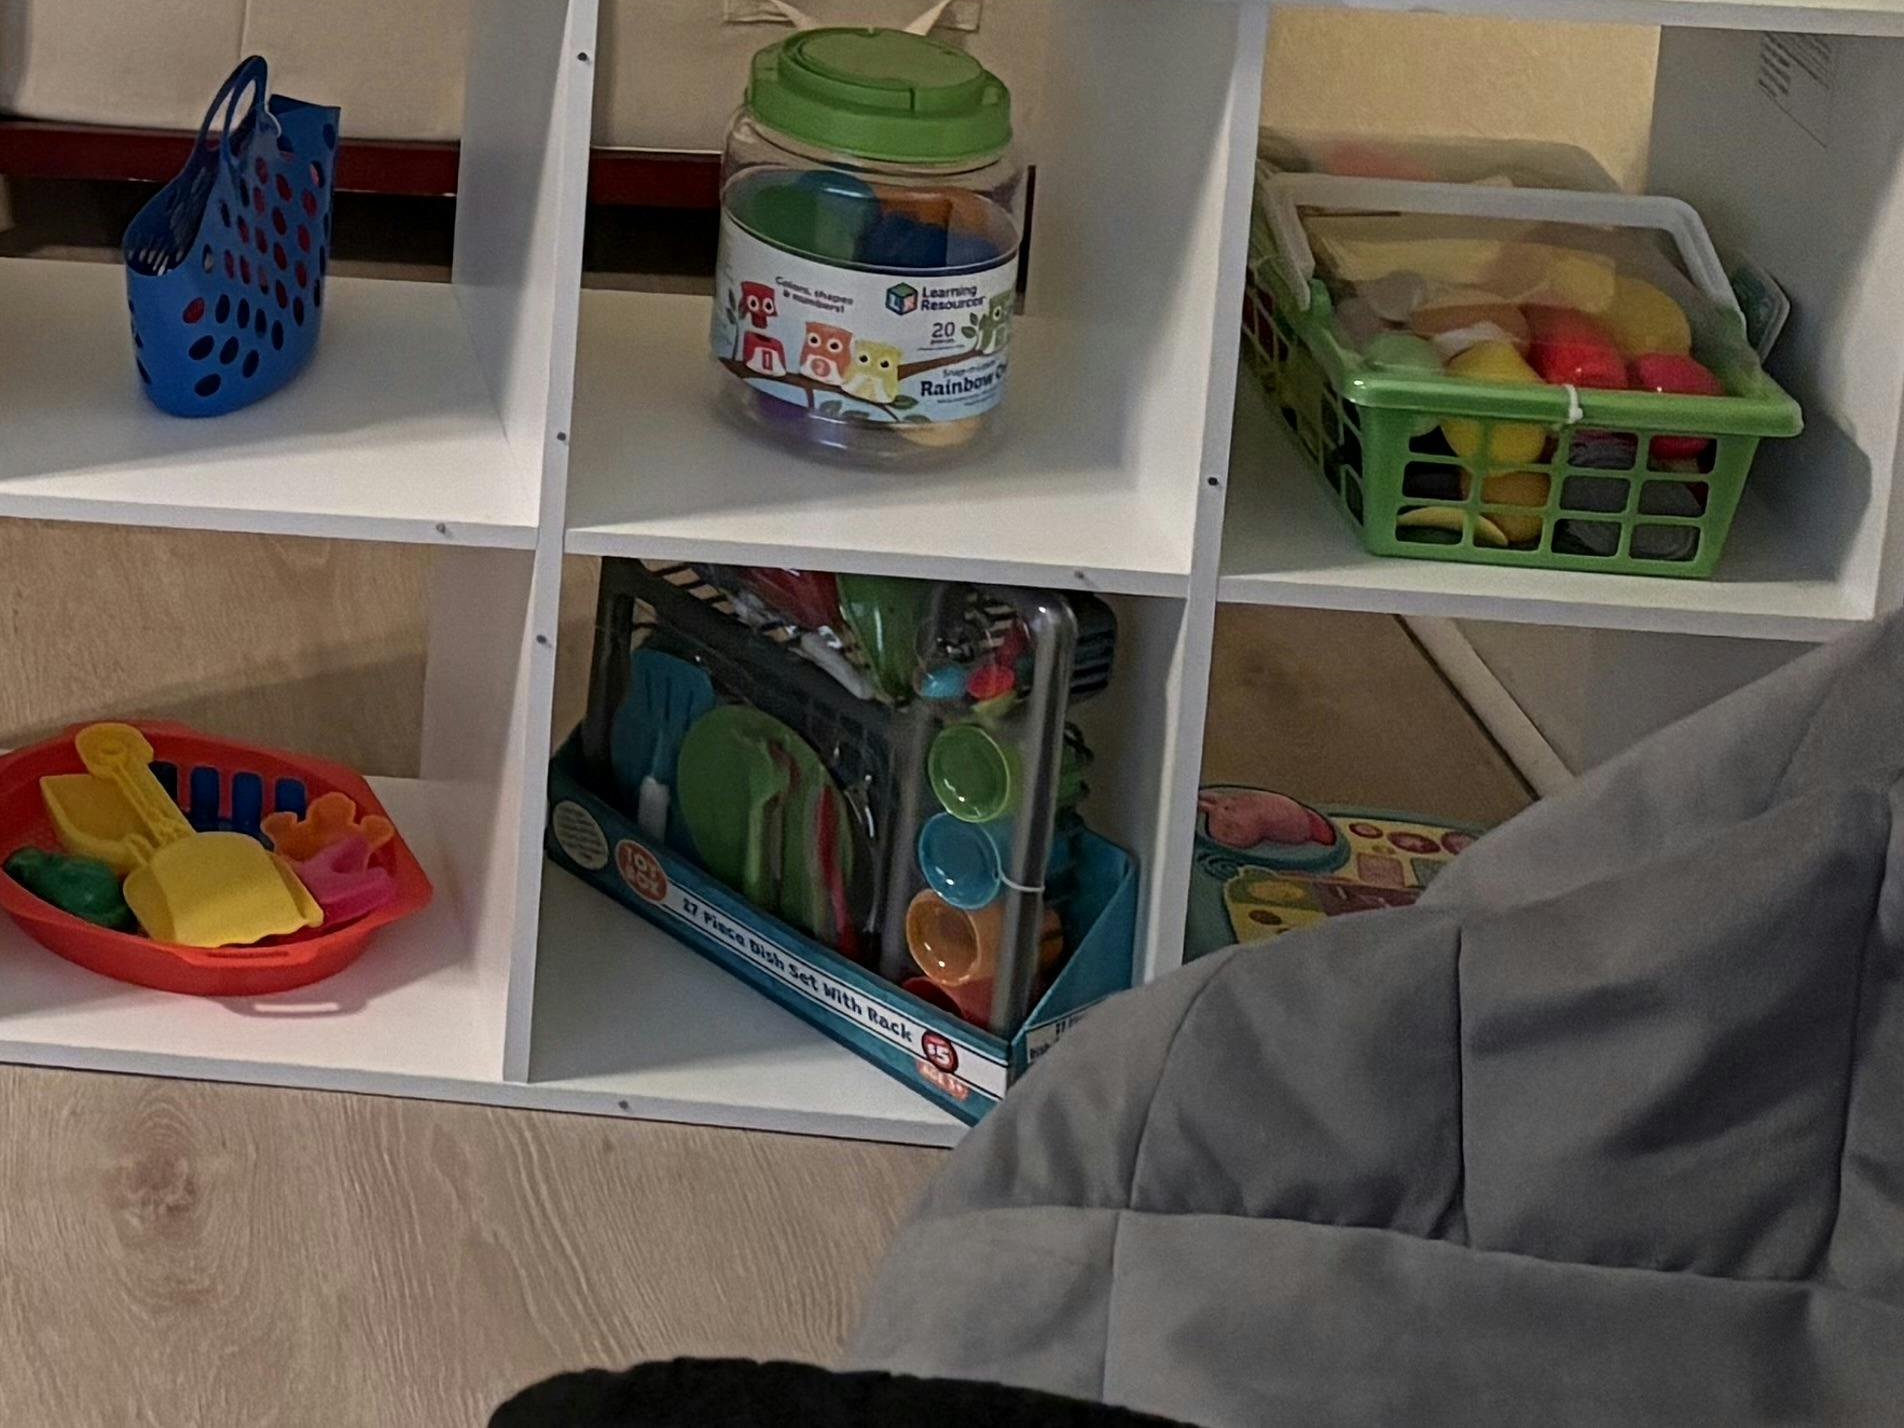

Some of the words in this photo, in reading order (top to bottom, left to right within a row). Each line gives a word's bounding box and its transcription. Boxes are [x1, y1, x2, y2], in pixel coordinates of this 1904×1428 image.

[921, 285, 977, 299] Learning
[932, 322, 955, 338] 20
[920, 374, 993, 397] Rainbow
[682, 897, 700, 916] 27
[703, 911, 745, 947] Piece
[750, 935, 786, 970] Dish
[789, 962, 820, 992] Set
[824, 982, 863, 1014] With
[867, 1005, 913, 1042] Rack
